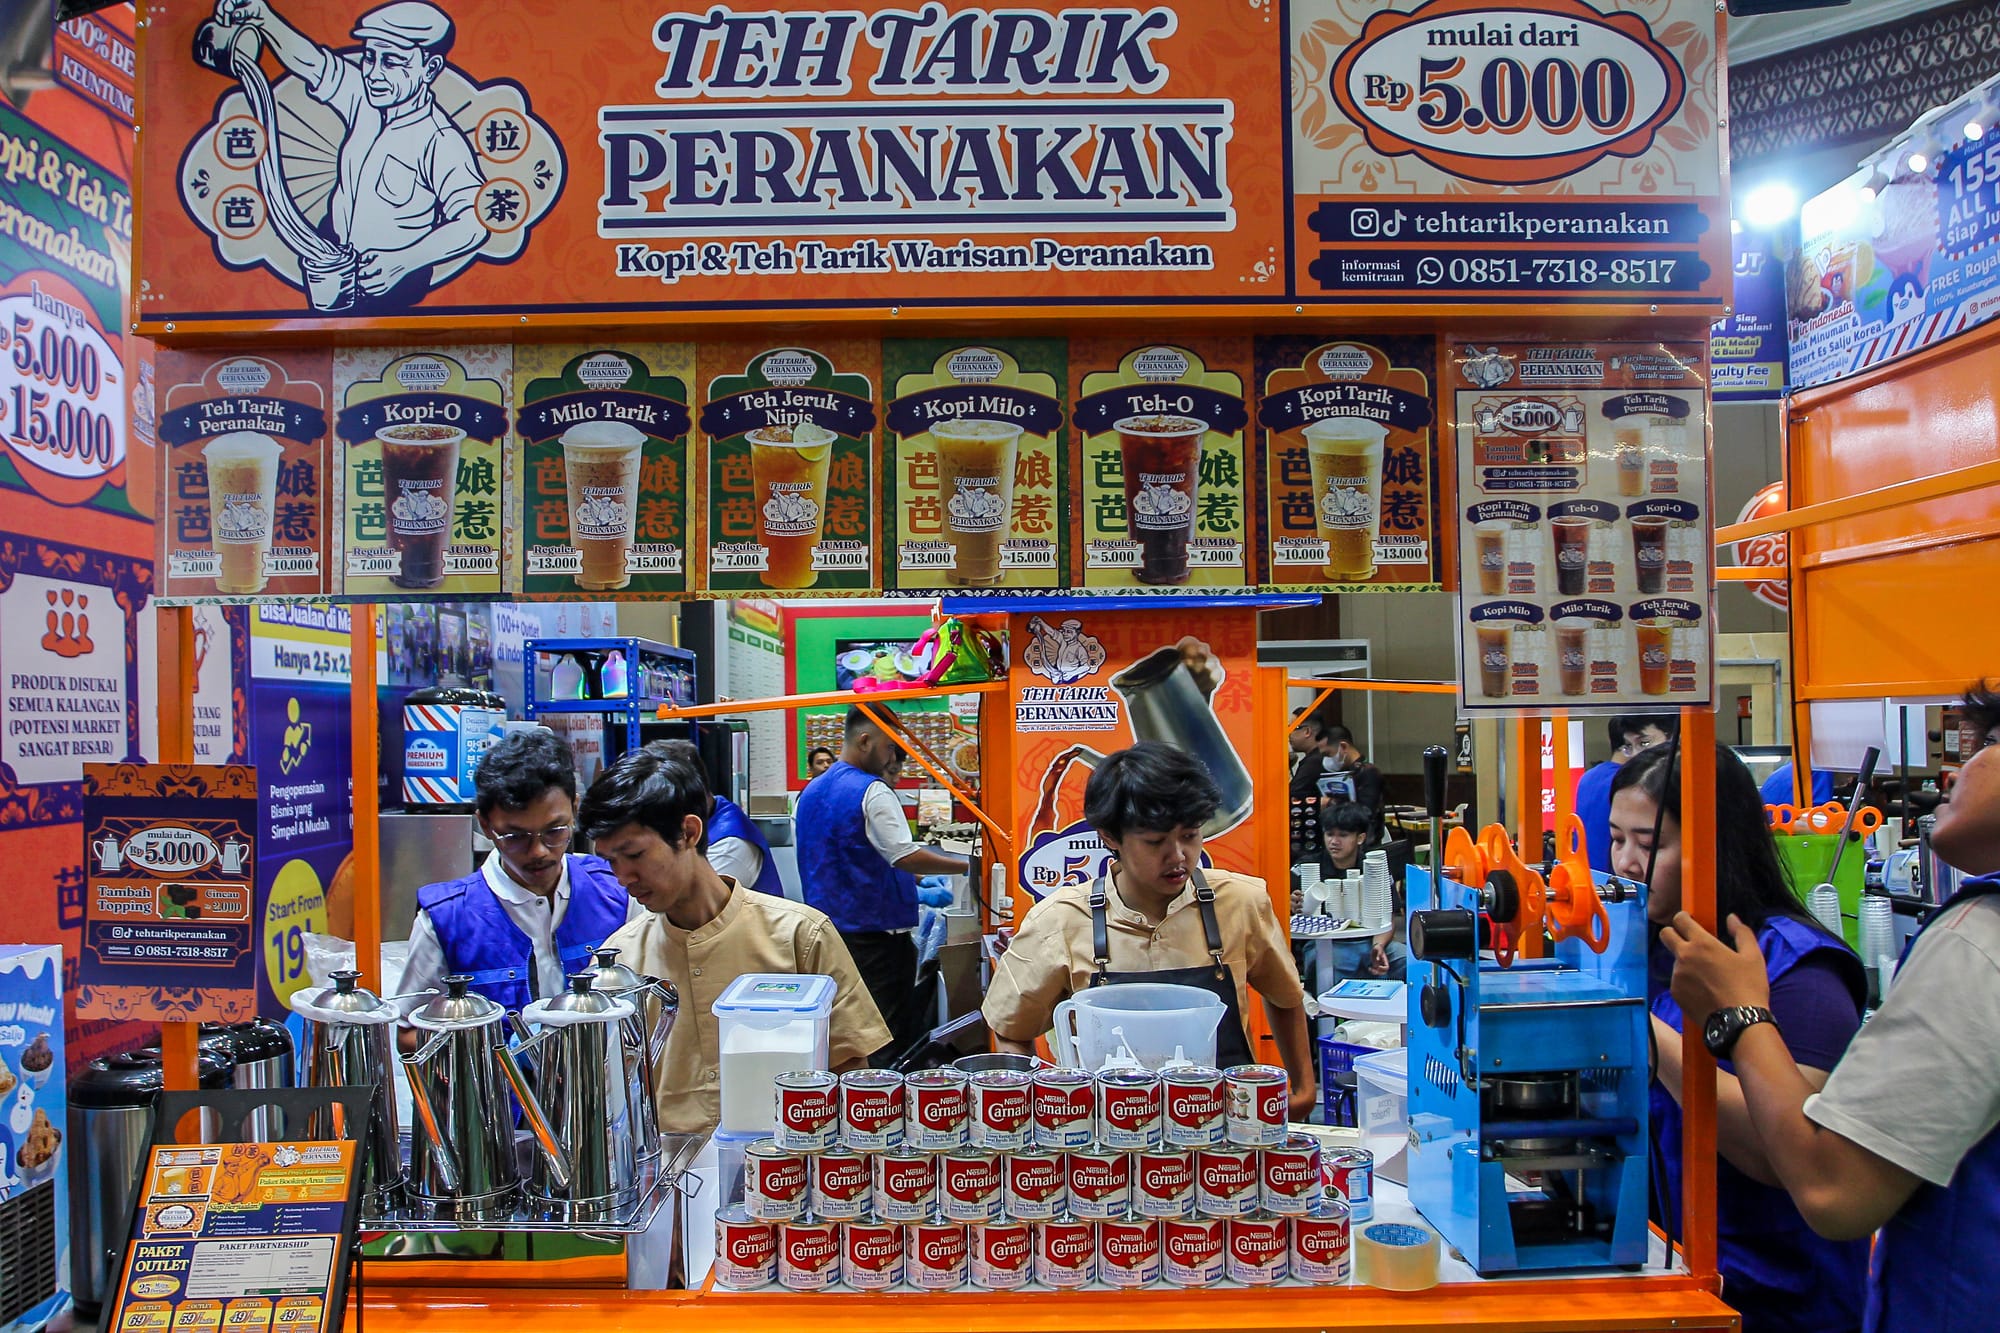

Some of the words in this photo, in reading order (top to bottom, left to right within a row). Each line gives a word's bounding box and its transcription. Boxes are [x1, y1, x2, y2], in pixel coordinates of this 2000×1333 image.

[1428, 23, 1513, 47] mulai
[1520, 22, 1578, 47] dari
[658, 10, 865, 92] TEH
[869, 8, 1173, 90] TARIK
[1365, 75, 1408, 108] Rp
[1418, 57, 1632, 131] 5.000
[603, 127, 1223, 205] PERANAKAN
[38, 151, 63, 195] &
[65, 161, 109, 223] Teh
[1415, 211, 1670, 239] tehtarikperanakan
[619, 246, 695, 277] Kopi
[702, 247, 728, 269] &
[733, 245, 793, 269] Teh
[799, 243, 887, 268] Tarik
[892, 243, 1027, 268] Warisan
[1034, 241, 1209, 267] Peranakan
[1341, 258, 1401, 272] informasi
[1341, 270, 1404, 283] kemitraan
[1449, 258, 1677, 285] 0851-7318-8517
[1932, 268, 1960, 293] FREE
[32, 280, 84, 329] hanya
[1736, 315, 1758, 323] Siap
[1809, 300, 1854, 331] Indonesia
[1809, 321, 1849, 346] Minuman
[1817, 346, 1827, 357] Es
[1853, 322, 1881, 342] Korea
[13, 312, 97, 396] 5.000
[1527, 348, 1556, 360] TEH
[1559, 348, 1595, 360] TARIK
[1520, 363, 1603, 375] PERANAKAN
[1747, 365, 1769, 376] Fee
[740, 393, 778, 411] Teh
[782, 390, 839, 411] Jeruk
[1298, 388, 1342, 406] Kopi
[1345, 385, 1394, 405] Tarik
[201, 402, 234, 418] Teh
[238, 400, 285, 418] Tarik
[925, 397, 976, 419] Kopi
[979, 396, 1026, 417] Milo
[1128, 394, 1194, 414] Teh-O
[384, 402, 461, 423] Kopi-O
[551, 402, 597, 425] Milo
[601, 401, 657, 423] Tarik
[765, 409, 813, 425] Nipis
[1301, 404, 1390, 421] Peranakan
[10, 384, 112, 466] 15.000
[199, 416, 286, 435] Peranakan
[719, 541, 761, 552] Reguler
[818, 540, 861, 550] JUMBO
[906, 540, 949, 551] Reguler
[1005, 538, 1049, 548] JUMBO
[1093, 538, 1136, 549] Reguler
[1192, 537, 1236, 547] JUMBO
[1280, 536, 1322, 546] Reguler
[1377, 535, 1420, 544] JUMBO
[175, 549, 215, 560] Reguler
[271, 547, 312, 557] JUMBO
[354, 547, 394, 558] Reguler
[449, 545, 491, 555] JUMBO
[534, 544, 575, 555] Reguler
[631, 543, 675, 553] JUMBO
[1284, 548, 1324, 560] 10.000
[1382, 547, 1422, 560] 13.000
[454, 557, 492, 570] 10.000
[538, 556, 577, 569] 13.000
[636, 555, 675, 569] 15.000
[726, 554, 759, 567] 7.000
[822, 552, 862, 566] 10.000
[911, 552, 950, 564] 13.000
[1010, 551, 1050, 564] 15.000
[1101, 551, 1134, 563] 5.000
[1201, 550, 1233, 563] 7.000
[182, 561, 213, 573] 7.000
[274, 558, 312, 571] 10.000
[361, 558, 392, 571] 7.000
[1561, 604, 1584, 615] Milo
[1586, 603, 1611, 614] Tarik
[274, 645, 310, 675] Hanya
[11, 674, 66, 691] PRODUK
[70, 677, 118, 692] DISUKAI
[1022, 687, 1057, 701] TEH
[1059, 686, 1108, 700] TARIK
[9, 696, 53, 712] SEMUA
[57, 697, 120, 713] KALANGAN
[1016, 706, 1117, 720] PERANAKAN
[9, 720, 69, 737] (POTENSI
[72, 720, 120, 734] MARKET
[19, 741, 69, 757] SANGAT
[73, 740, 113, 756] BESAR)
[406, 752, 444, 760] PREMIUM
[270, 780, 325, 800] Pengoperasian
[271, 804, 293, 819] Bisnis
[295, 802, 313, 818] yang
[147, 831, 173, 839] mulai
[174, 831, 192, 839] dari
[271, 822, 298, 840] Simpel
[305, 819, 330, 833] Mudah
[145, 841, 206, 865] 5.000
[1033, 866, 1056, 884] Rp
[99, 886, 151, 898] Tambah
[99, 900, 152, 914] Topping
[269, 901, 296, 921] Start
[298, 894, 323, 913] From
[135, 929, 227, 940] tehtarikperanakan
[146, 946, 228, 957] 0851-7318-8517
[1035, 1098, 1087, 1117] Carnation
[1073, 1169, 1126, 1188] Carnation
[138, 1246, 184, 1258] PAKET
[218, 1241, 249, 1250] PAKET
[249, 1240, 310, 1250] PARTNERSHIP
[135, 1259, 190, 1272] OUTLET
